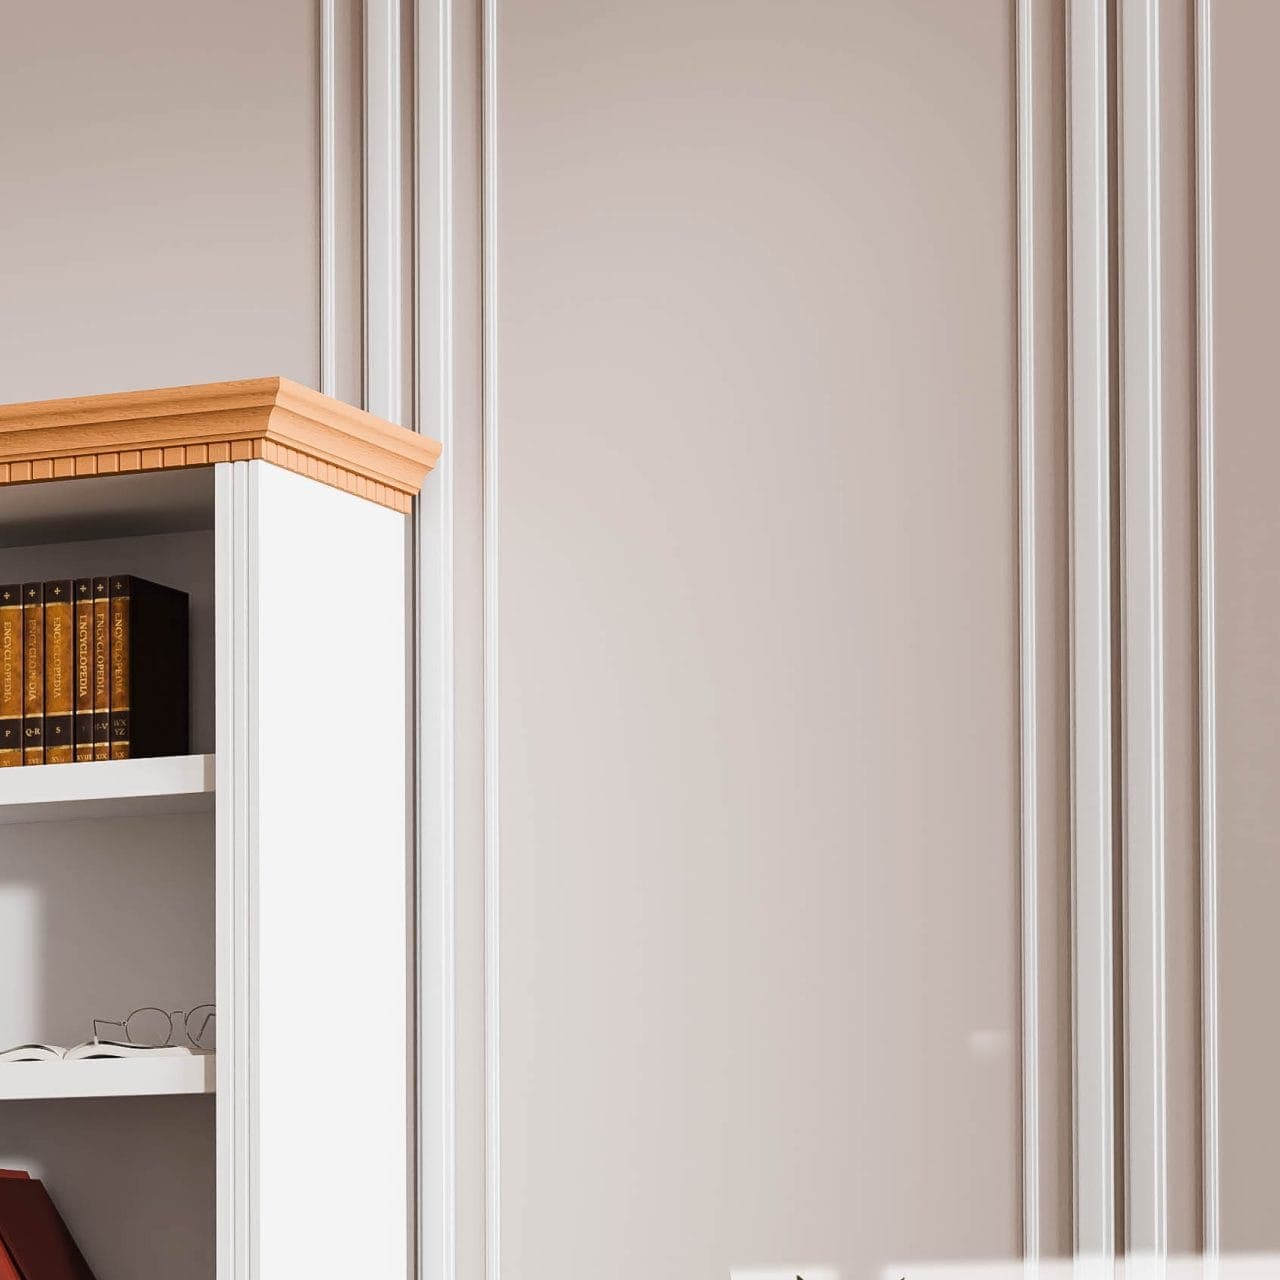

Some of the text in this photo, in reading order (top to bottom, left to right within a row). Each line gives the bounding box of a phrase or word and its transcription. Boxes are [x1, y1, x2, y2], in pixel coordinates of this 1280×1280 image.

[4, 621, 12, 703] ENCYCLOPEDIA
[79, 614, 88, 698] ENCYCLOPEDIA
[96, 613, 105, 696] ENCYCLOPEDIA
